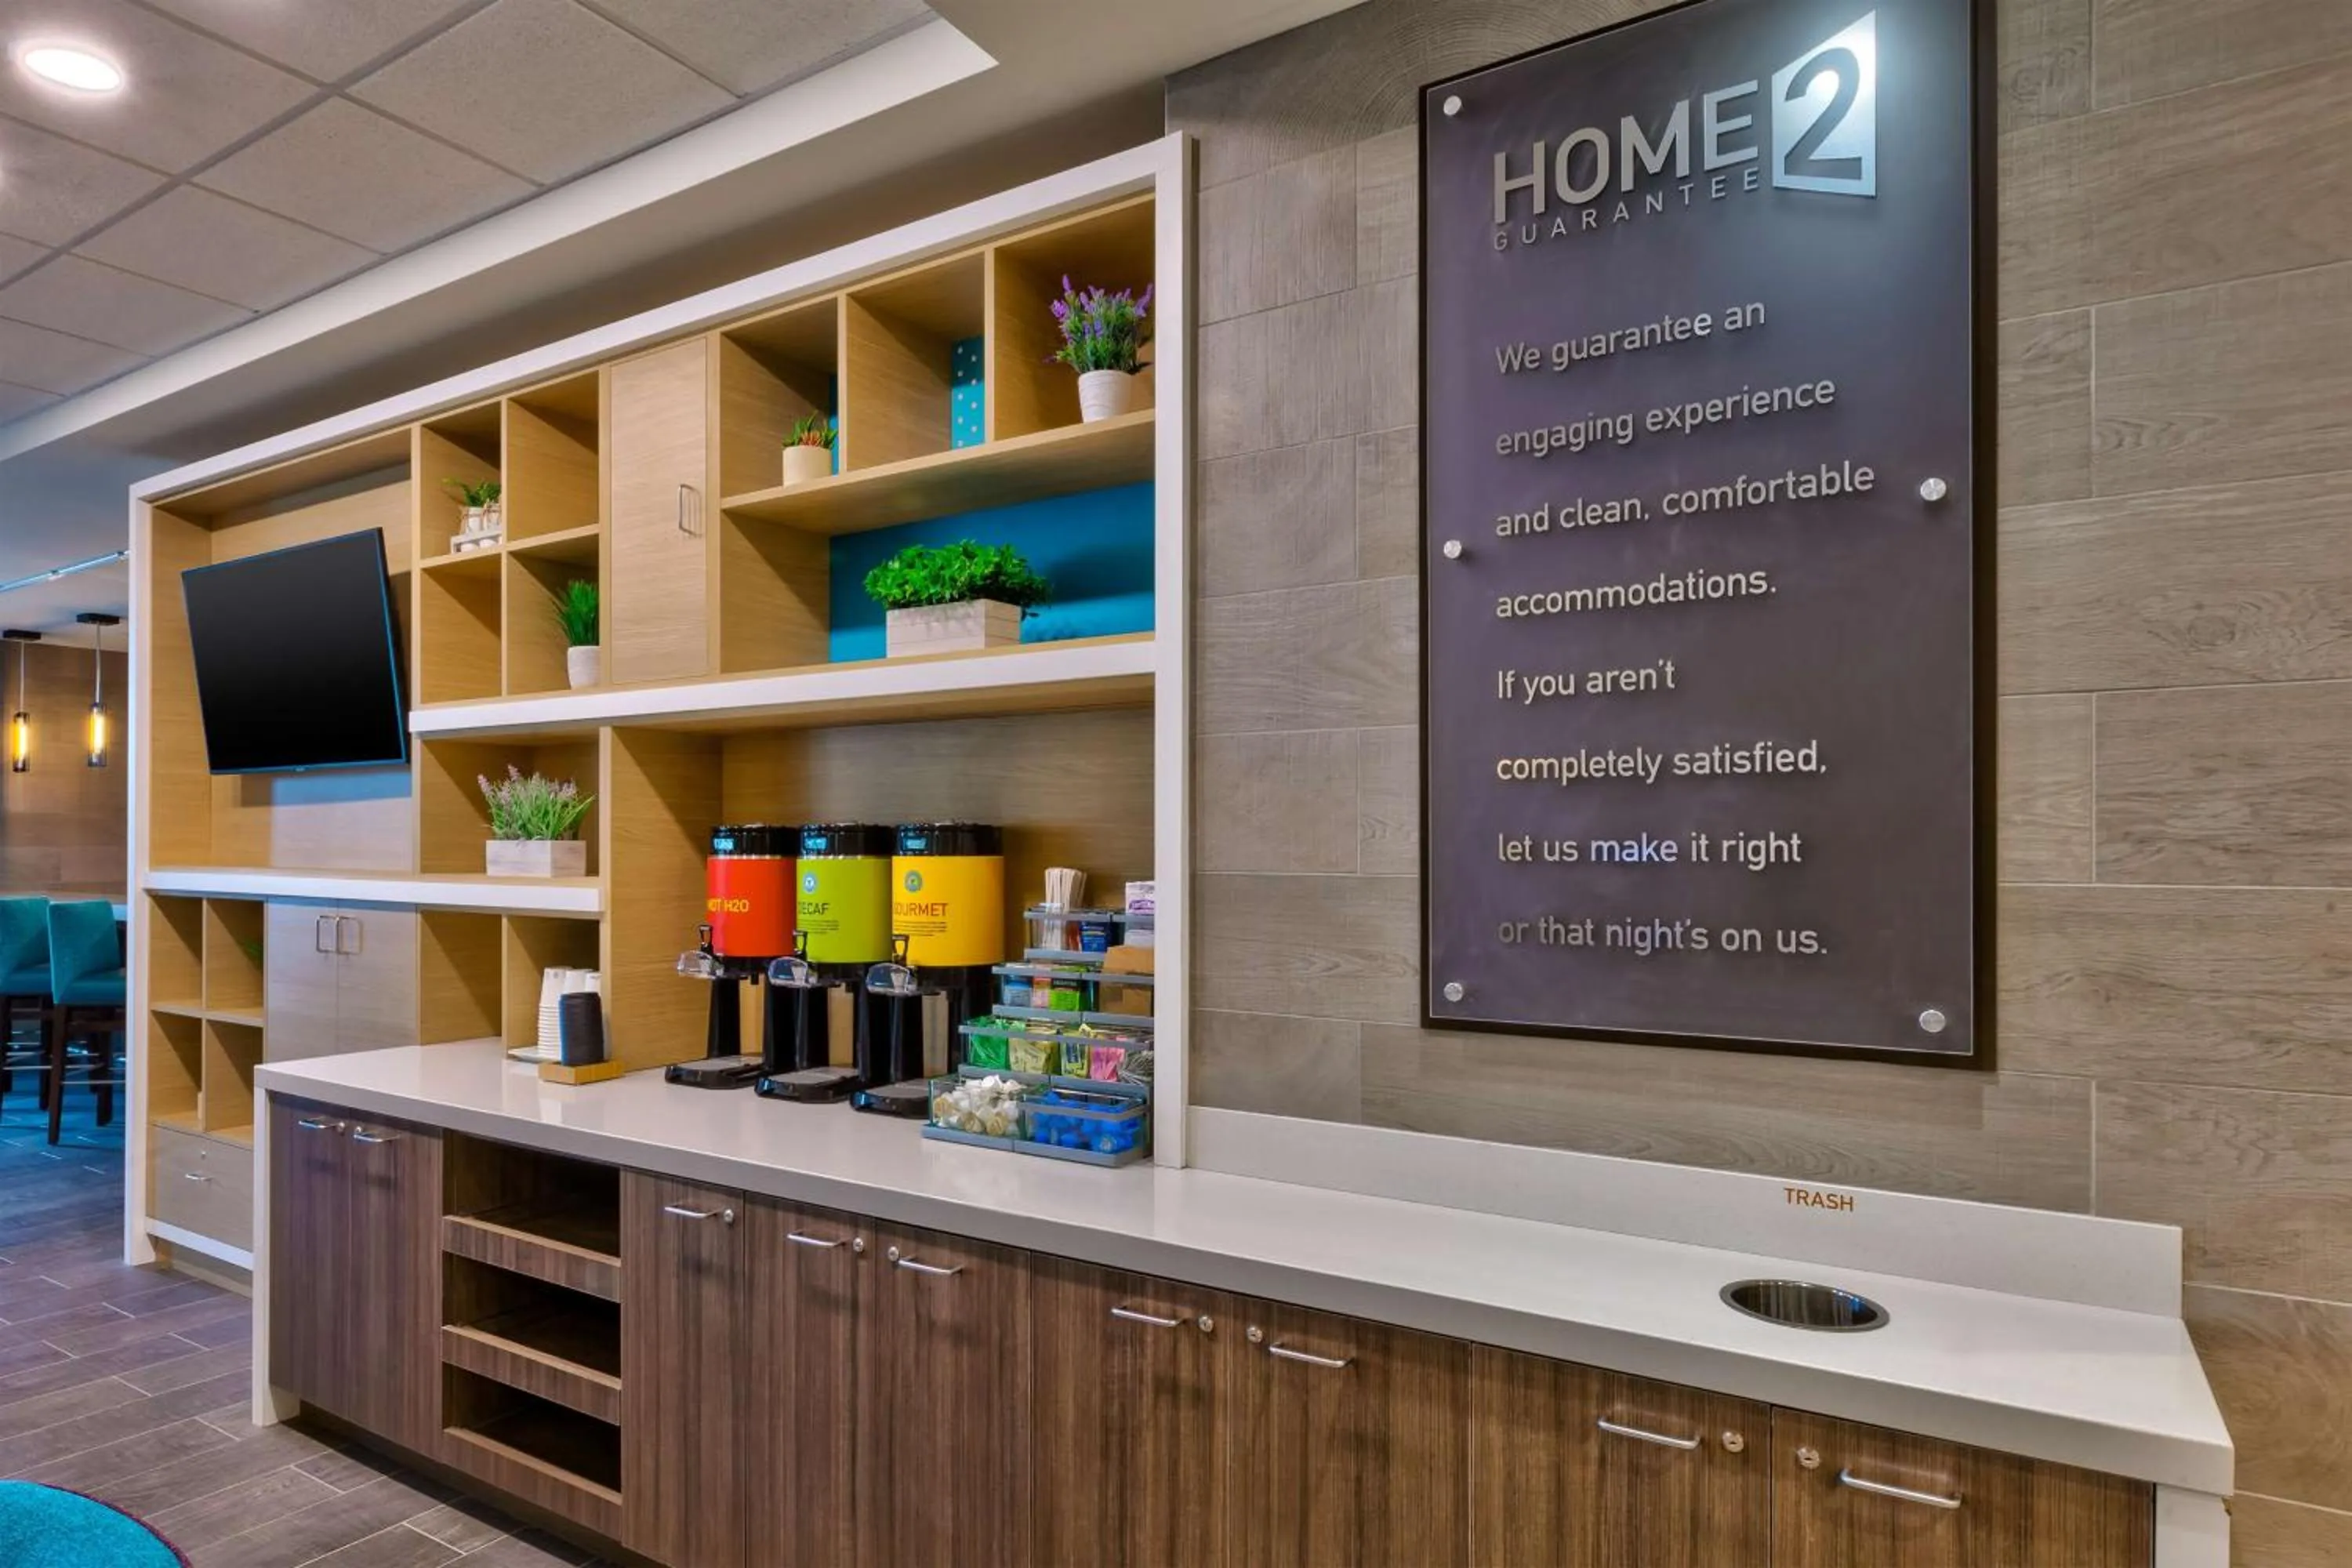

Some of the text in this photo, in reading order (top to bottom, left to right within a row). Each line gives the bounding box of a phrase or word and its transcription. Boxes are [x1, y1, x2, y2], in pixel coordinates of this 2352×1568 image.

[1494, 79, 1759, 224] HOME
[1494, 167, 1759, 252] GUARANTEE
[1496, 301, 1766, 374] We guarantee an
[1496, 379, 1835, 459] engaging experience
[1496, 503, 1549, 536] and
[1662, 461, 1875, 516] comfortable
[1497, 569, 1777, 618] accommodations.
[1497, 659, 1675, 704] If you aren't
[1497, 740, 1828, 786] completely satisfied,
[1498, 833, 1802, 871] let us make it right
[707, 898, 750, 913] OT H2O
[798, 902, 830, 915] ECAF
[893, 902, 948, 916] OURMET
[1497, 916, 1828, 956] or that night's on us.
[1784, 1187, 1853, 1212] TRASH
